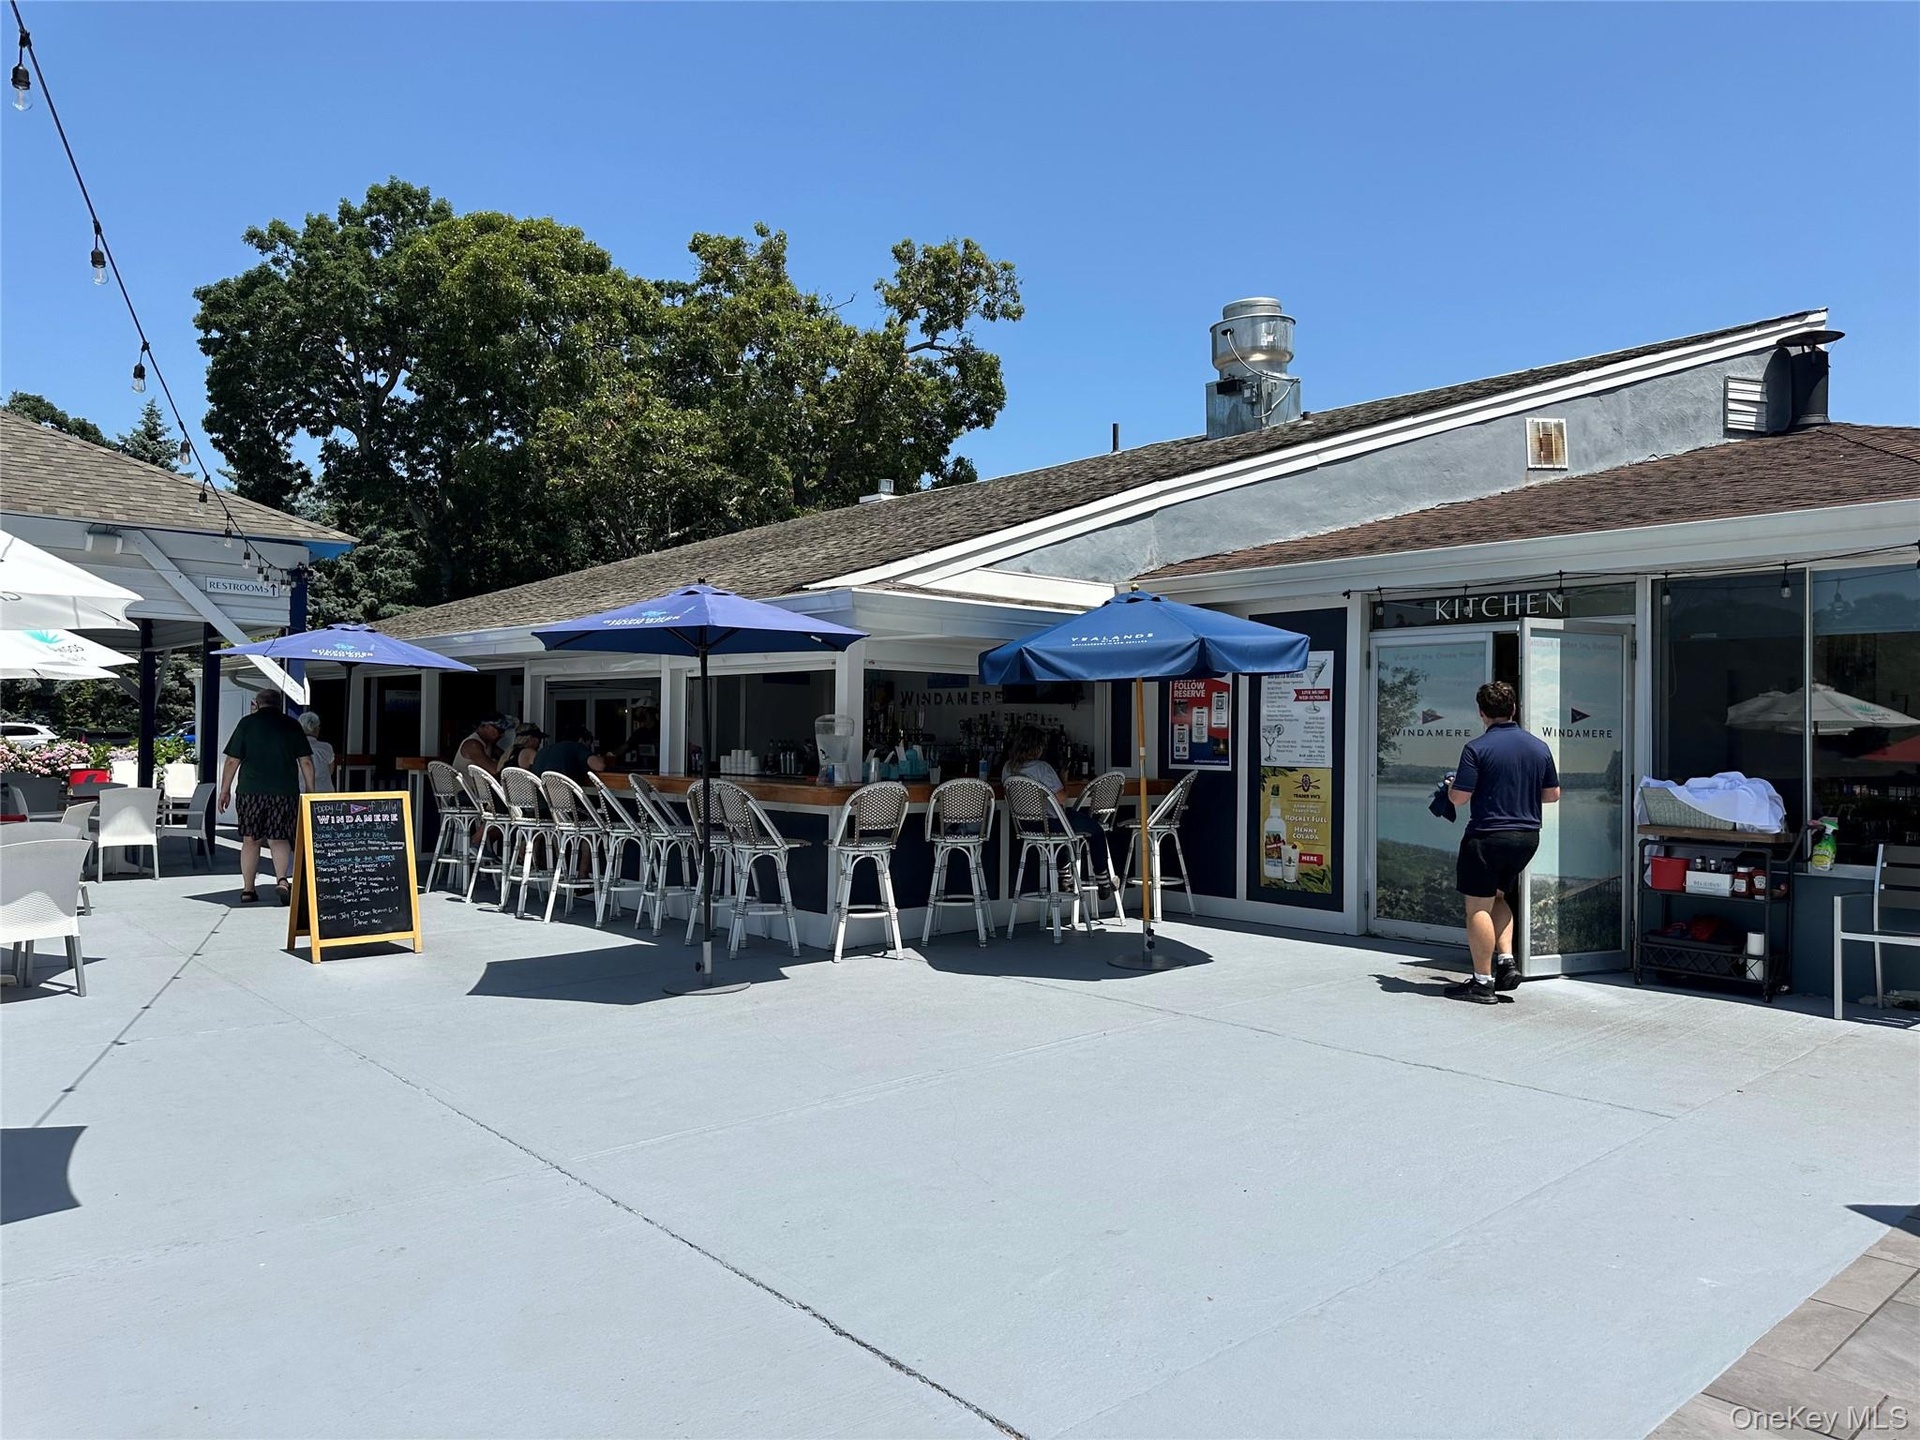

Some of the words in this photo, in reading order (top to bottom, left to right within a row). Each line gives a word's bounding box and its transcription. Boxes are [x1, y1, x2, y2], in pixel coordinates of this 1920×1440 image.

[209, 581, 269, 594] RESTROOMS
[1435, 591, 1564, 621] KITCHEN
[1174, 681, 1205, 690] FOLLOW
[900, 690, 1004, 707] WINDAMERE
[1173, 689, 1206, 698] RESERVE
[1389, 728, 1472, 738] WINDAMERE
[1541, 726, 1613, 739] WINDAMERE
[313, 803, 334, 814] Happy
[367, 801, 376, 813] of
[317, 814, 398, 824] WINDAMERE
[1312, 815, 1328, 823] FUEL
[1294, 826, 1318, 834] HENNY
[1292, 832, 1319, 840] COLADA
